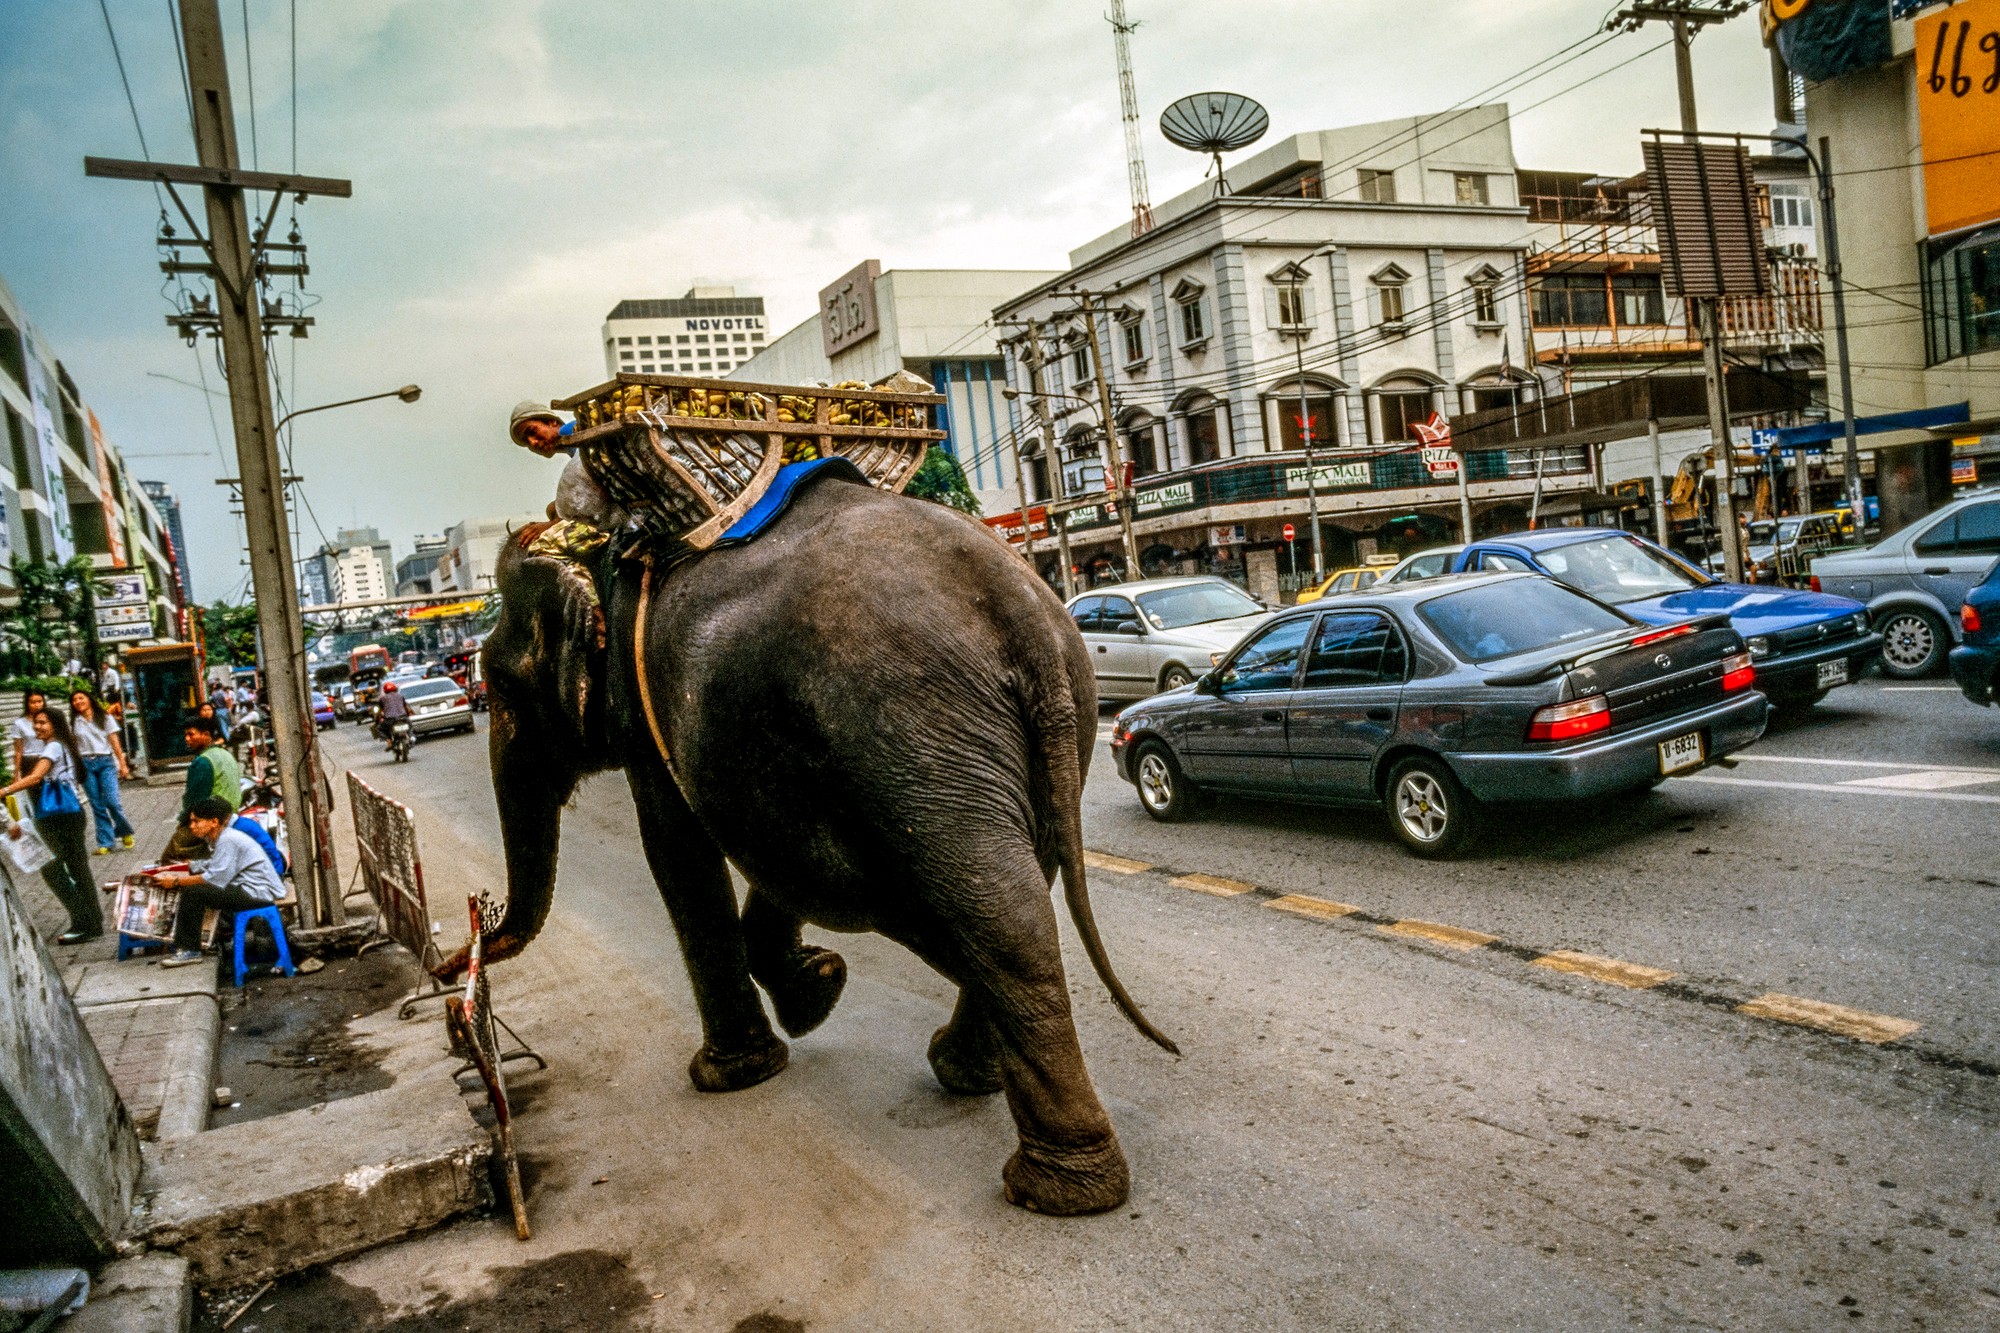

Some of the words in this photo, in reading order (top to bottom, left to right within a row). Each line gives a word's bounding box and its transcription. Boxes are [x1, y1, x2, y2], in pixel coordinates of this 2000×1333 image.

[686, 317, 764, 331] NOVOTEL
[1289, 468, 1328, 482] PIZZA
[1333, 464, 1368, 478] MALL
[1137, 491, 1163, 505] PIZZA
[1165, 485, 1190, 499] MALL
[100, 627, 150, 638] EXCHANGE
